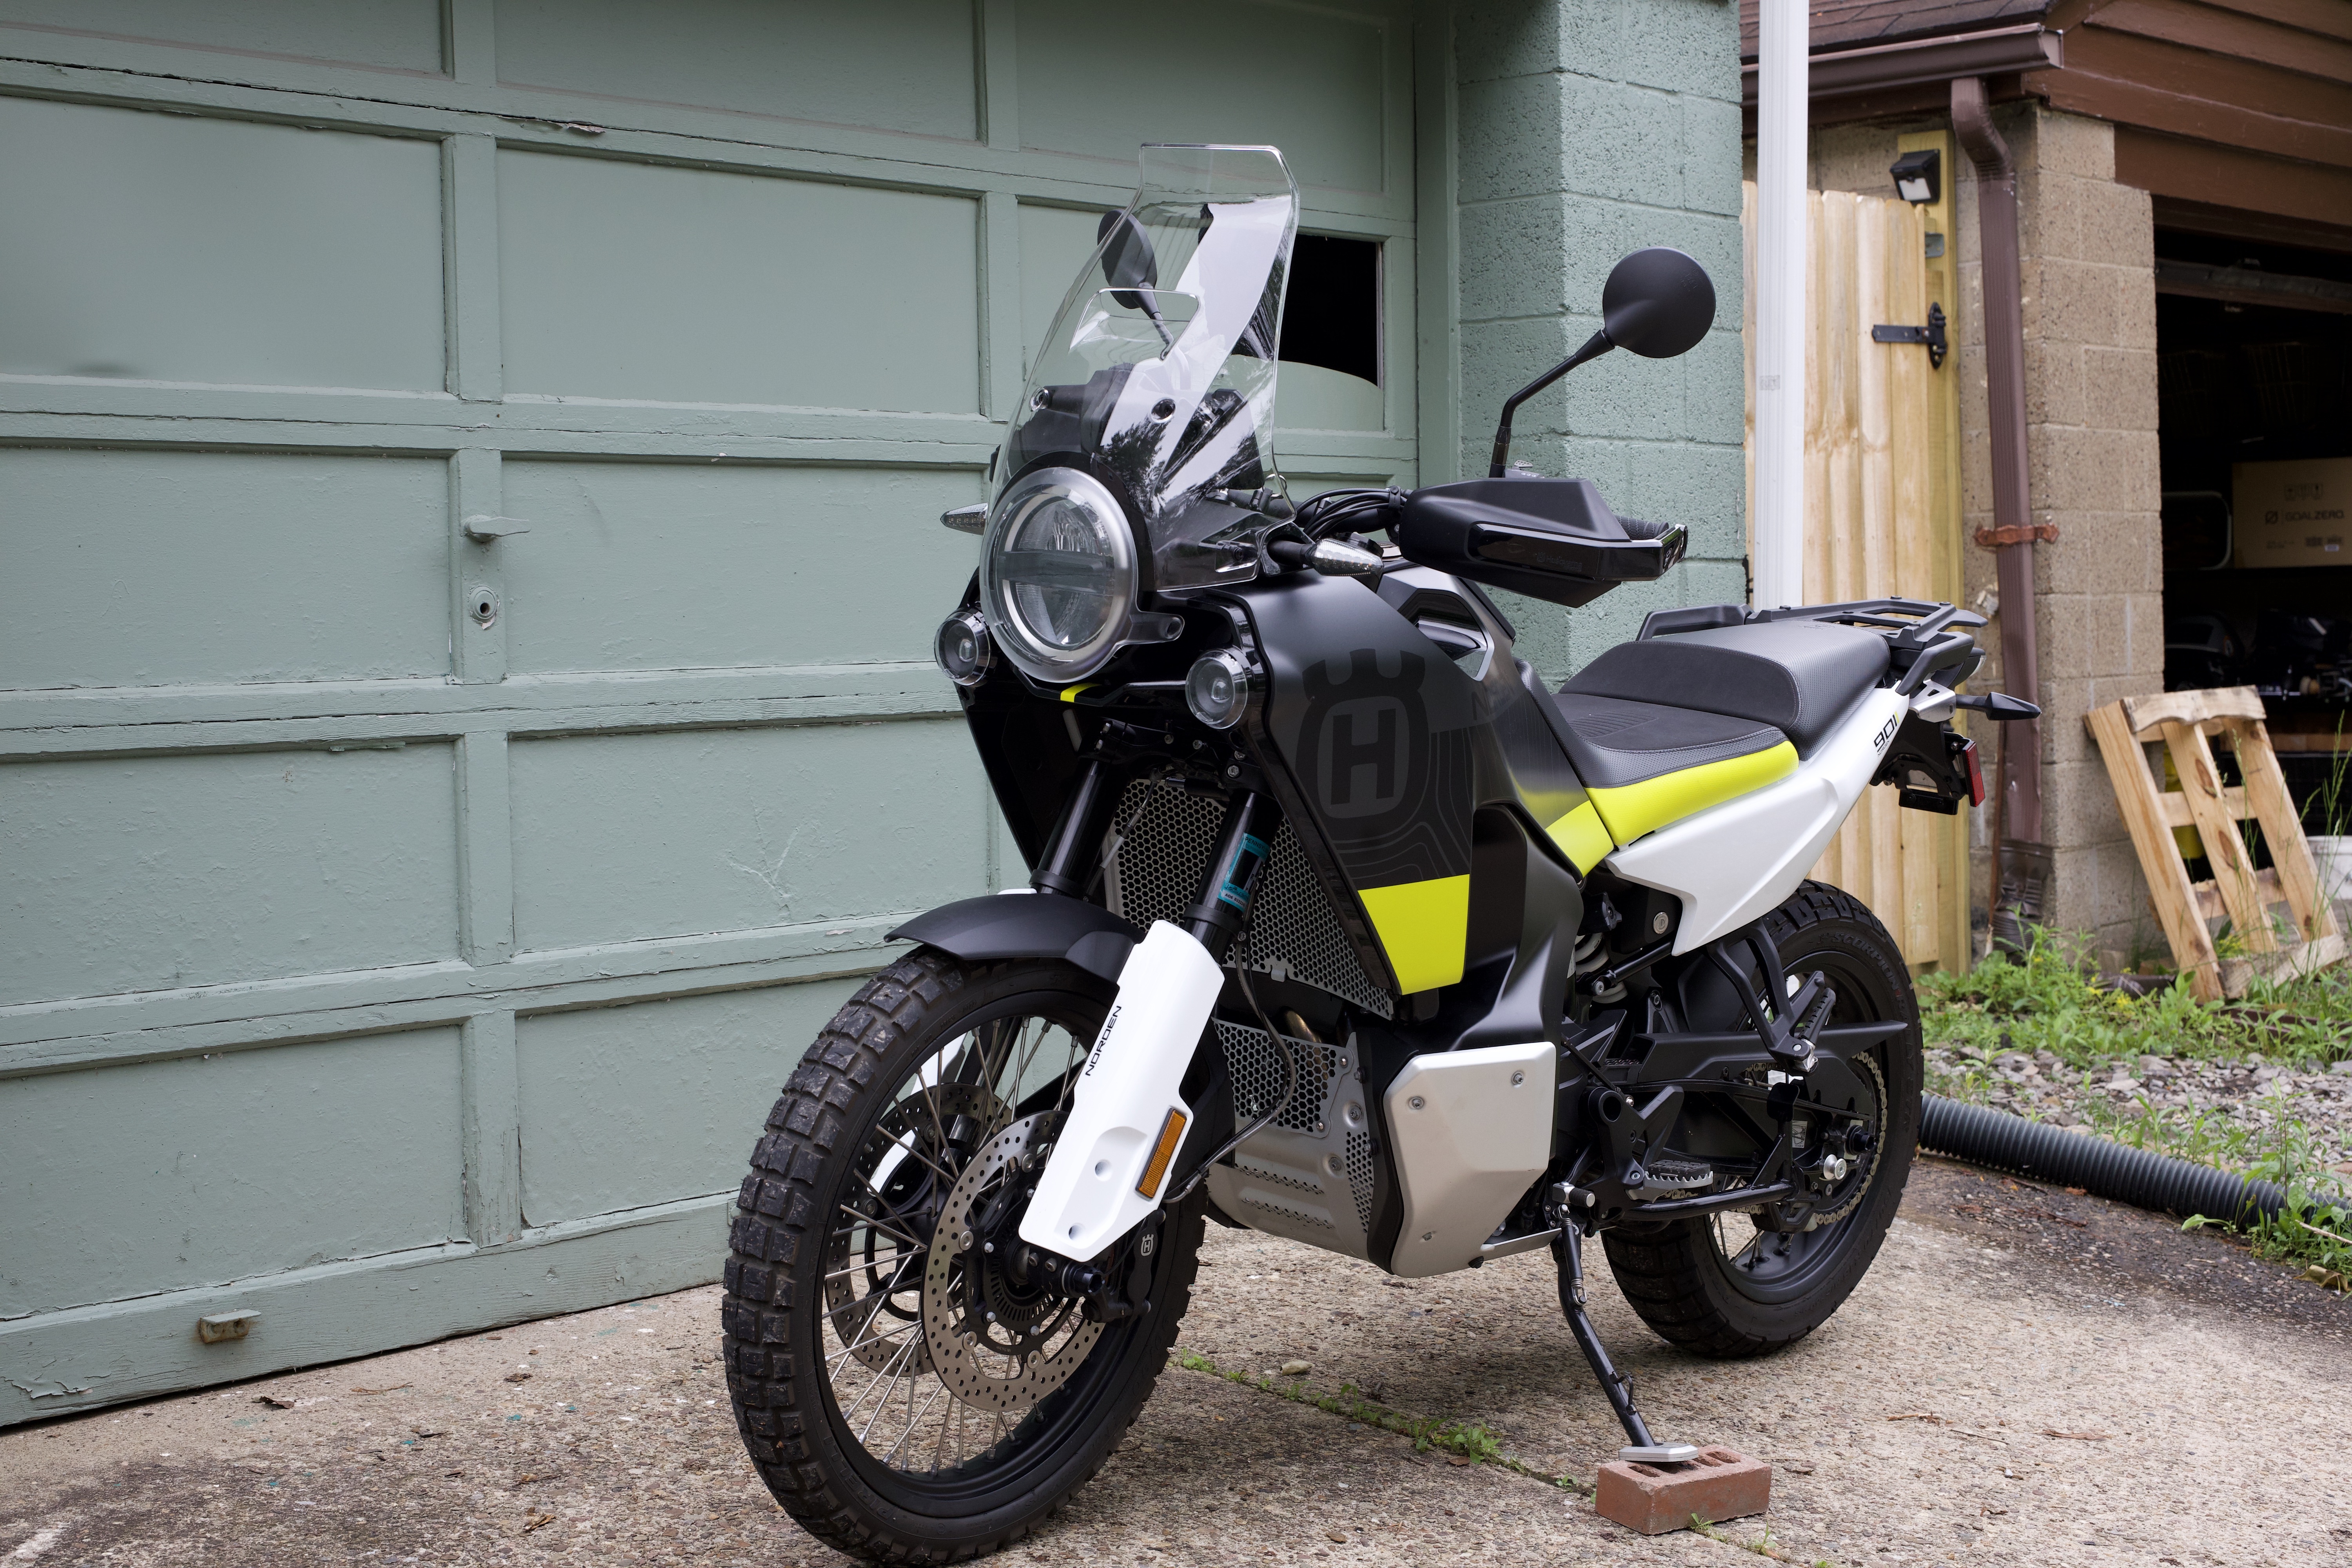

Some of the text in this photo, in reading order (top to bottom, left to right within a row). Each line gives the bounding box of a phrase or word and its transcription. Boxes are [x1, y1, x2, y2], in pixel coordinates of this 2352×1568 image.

[1330, 708, 1396, 806] H
[1873, 714, 1897, 753] 901
[1831, 932, 1900, 990] SCORPION
[1086, 1005, 1122, 1077] NORDEN
[823, 1436, 894, 1519] PIRELLI
